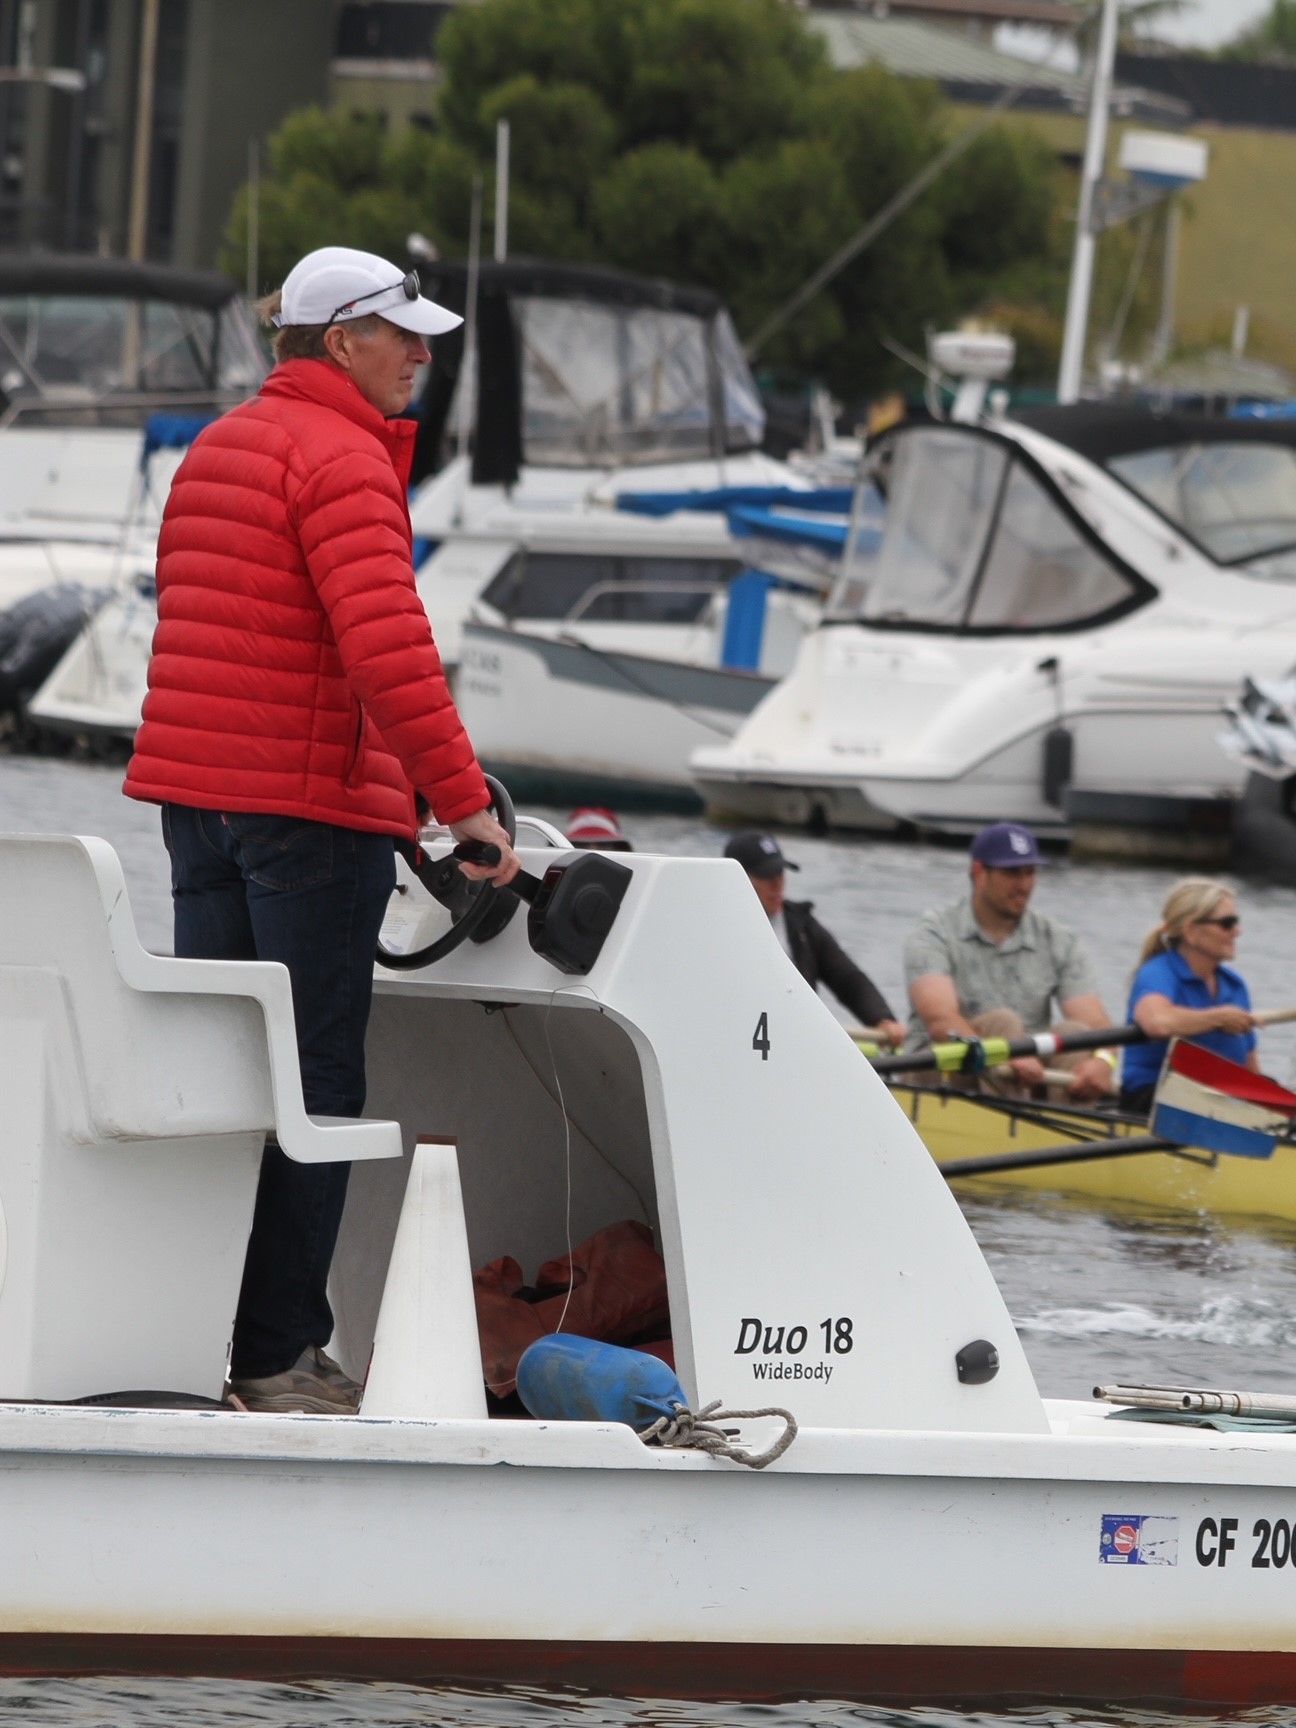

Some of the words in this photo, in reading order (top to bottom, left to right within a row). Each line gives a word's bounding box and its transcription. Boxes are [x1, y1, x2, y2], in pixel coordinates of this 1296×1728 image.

[752, 1011, 771, 1061] 4
[733, 1317, 808, 1355] Duo
[819, 1316, 853, 1355] 18
[752, 1361, 834, 1385] WideBody
[1195, 1517, 1239, 1568] CF
